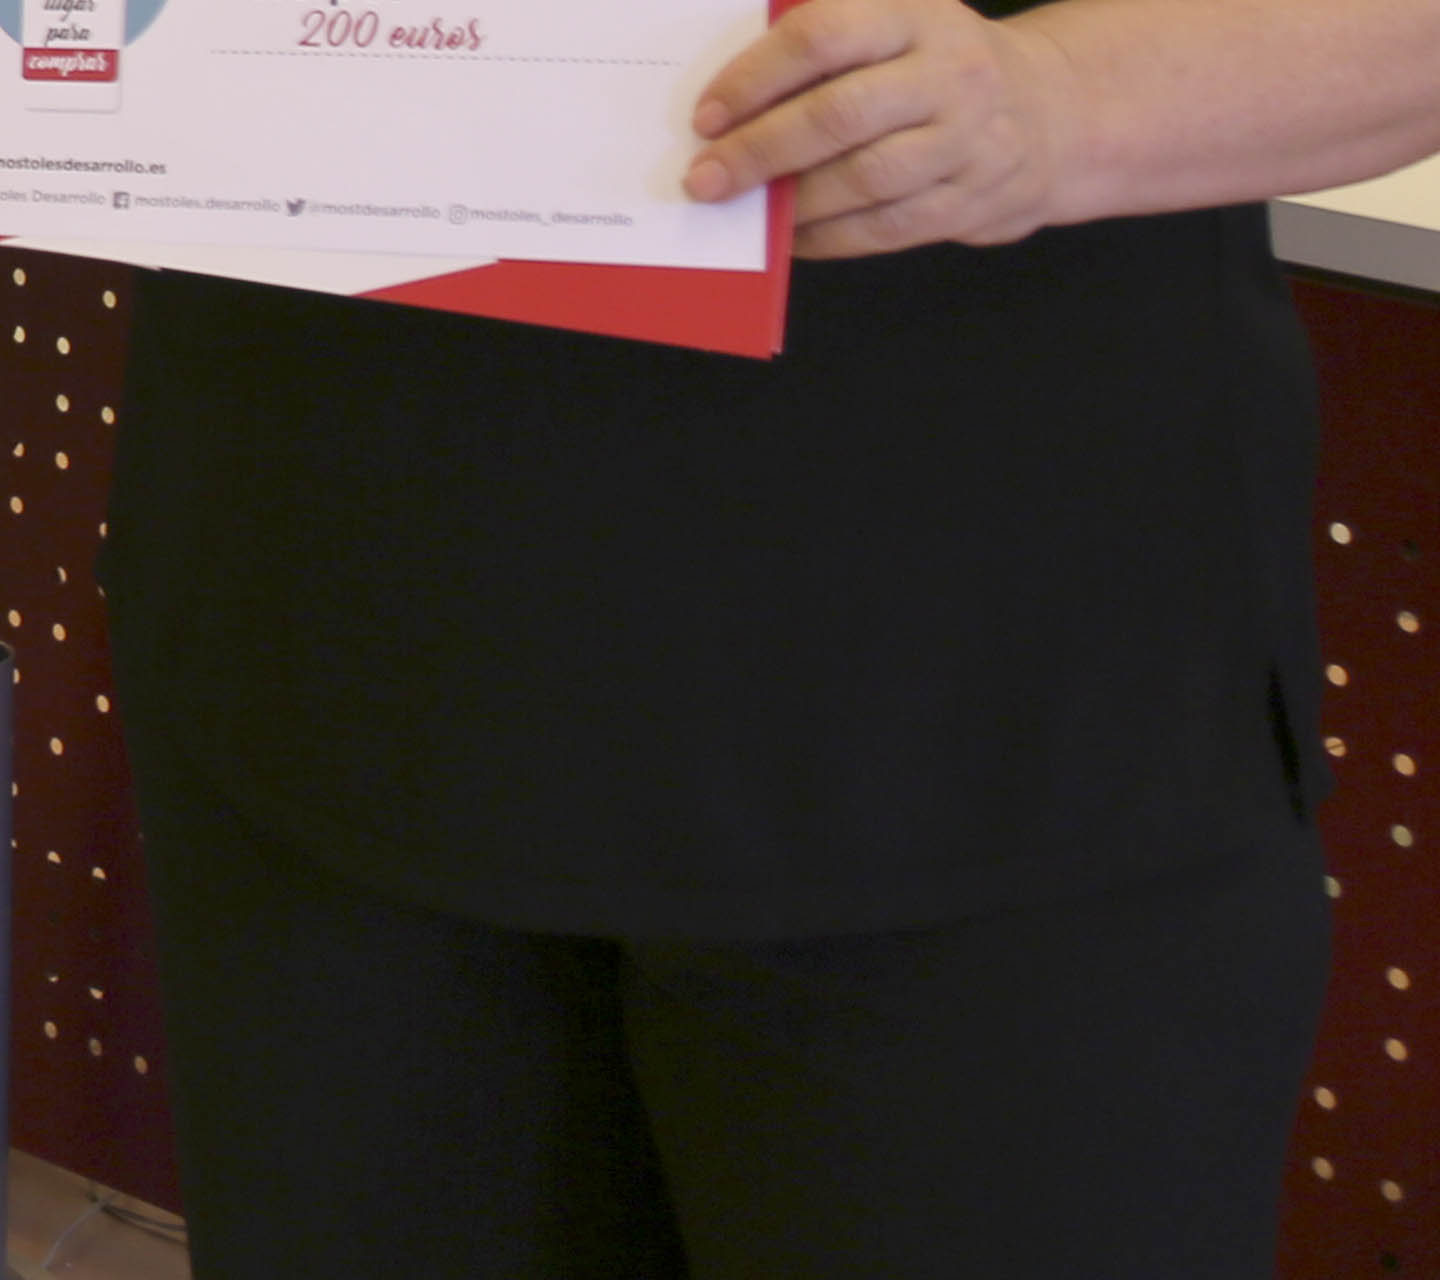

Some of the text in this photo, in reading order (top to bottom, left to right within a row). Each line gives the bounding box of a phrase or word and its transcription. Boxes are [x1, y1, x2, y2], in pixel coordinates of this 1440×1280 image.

[43, 23, 91, 48] para
[296, 9, 483, 51] 200 euros
[28, 51, 108, 78] comprar
[32, 190, 107, 207] Desarrollo
